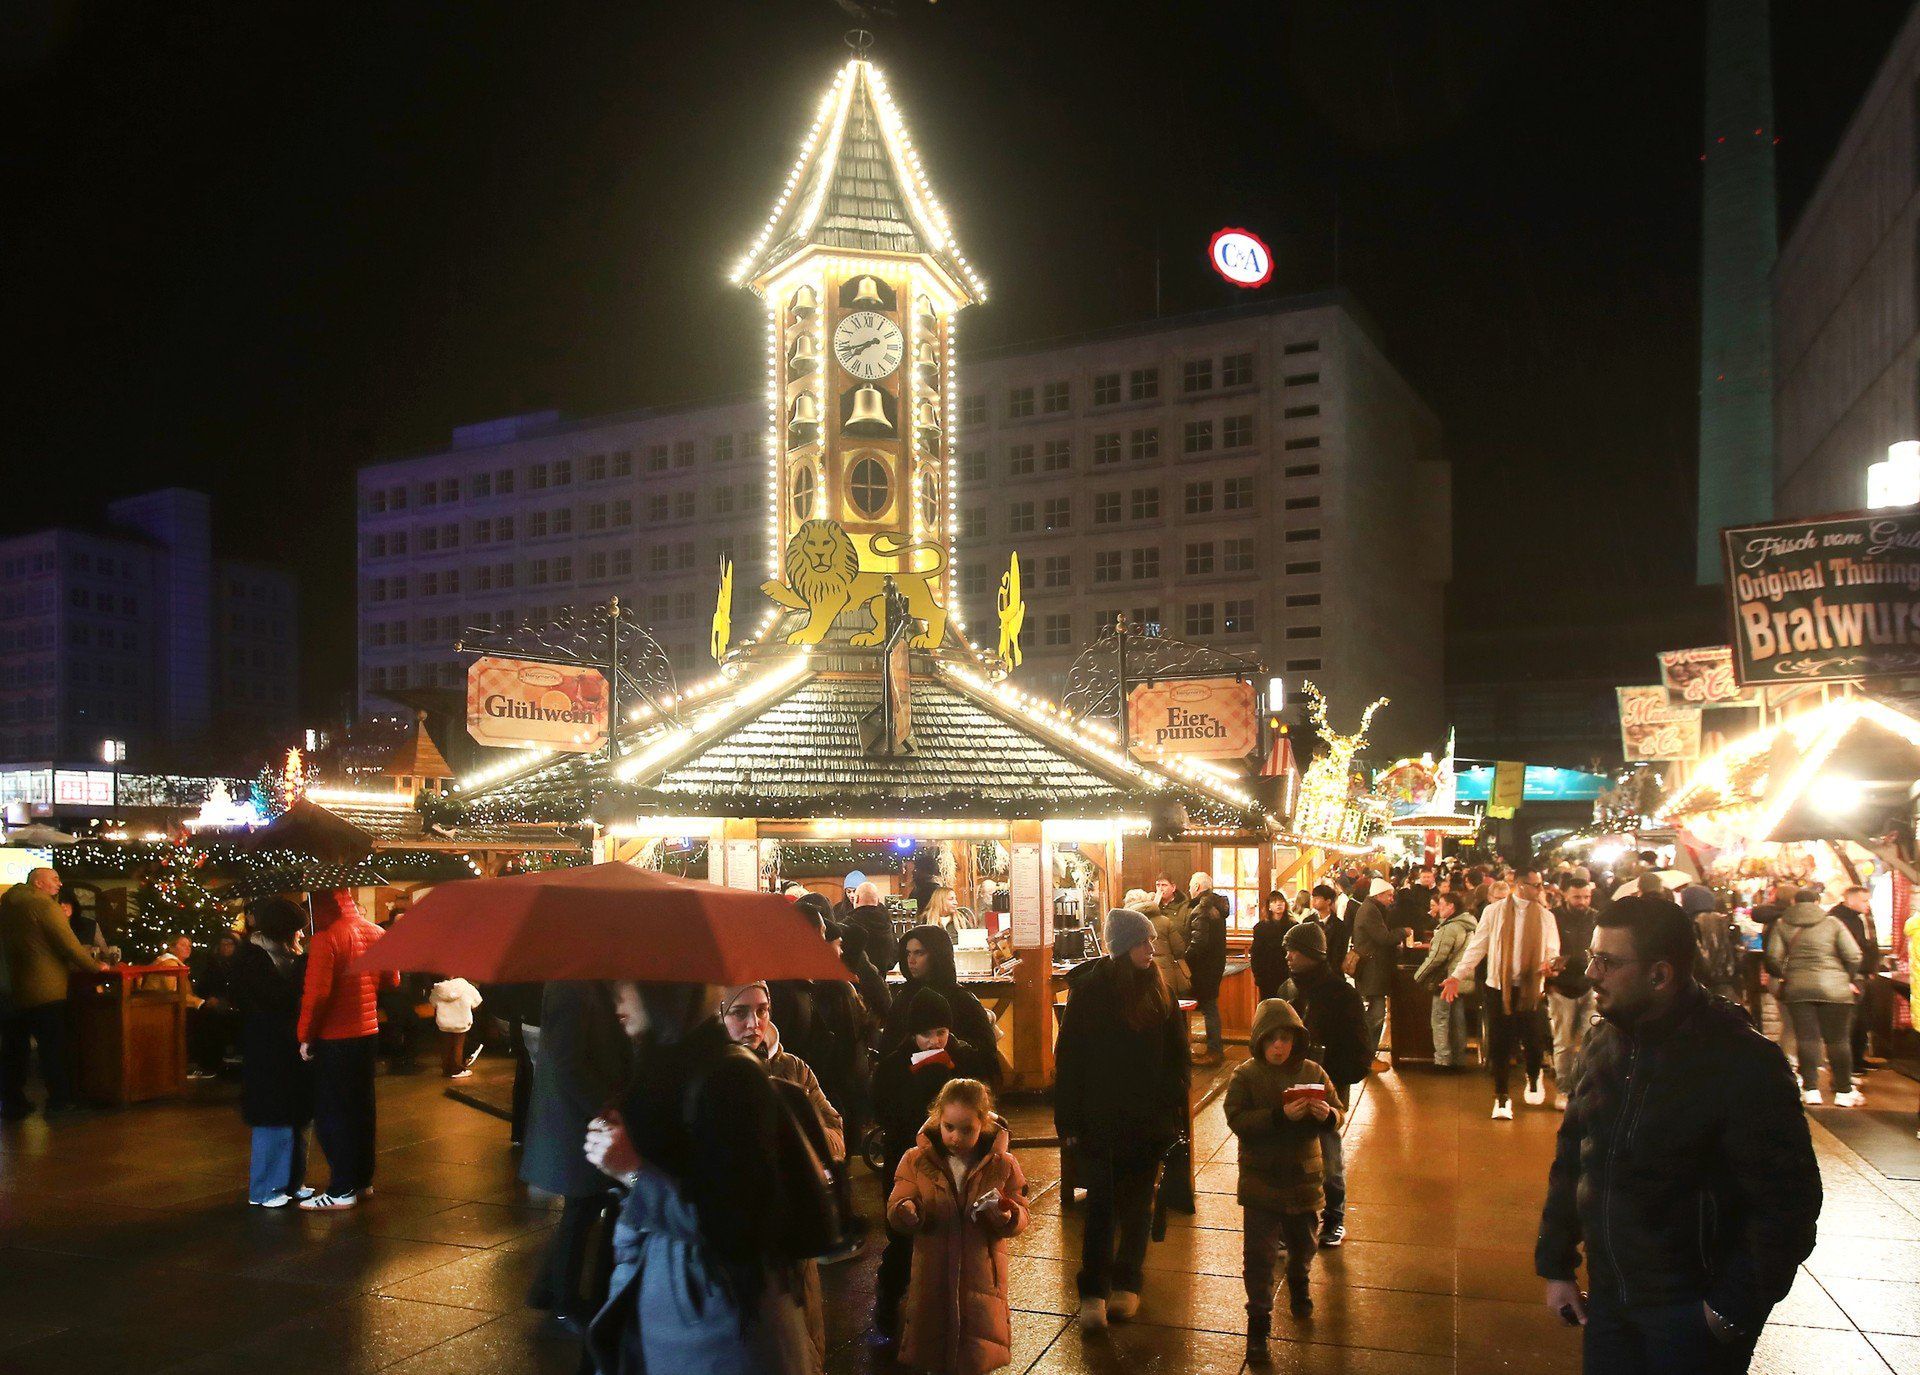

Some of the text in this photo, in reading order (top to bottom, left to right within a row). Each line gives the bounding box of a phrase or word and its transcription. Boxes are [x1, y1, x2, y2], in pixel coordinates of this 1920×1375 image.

[1222, 242, 1262, 274] C&A
[1740, 529, 1819, 568] Frisch
[1822, 532, 1864, 547] vom
[1737, 560, 1825, 602] Original
[484, 694, 594, 725] Glühwein
[1166, 707, 1216, 728] Eier-
[1156, 720, 1228, 745] punsch
